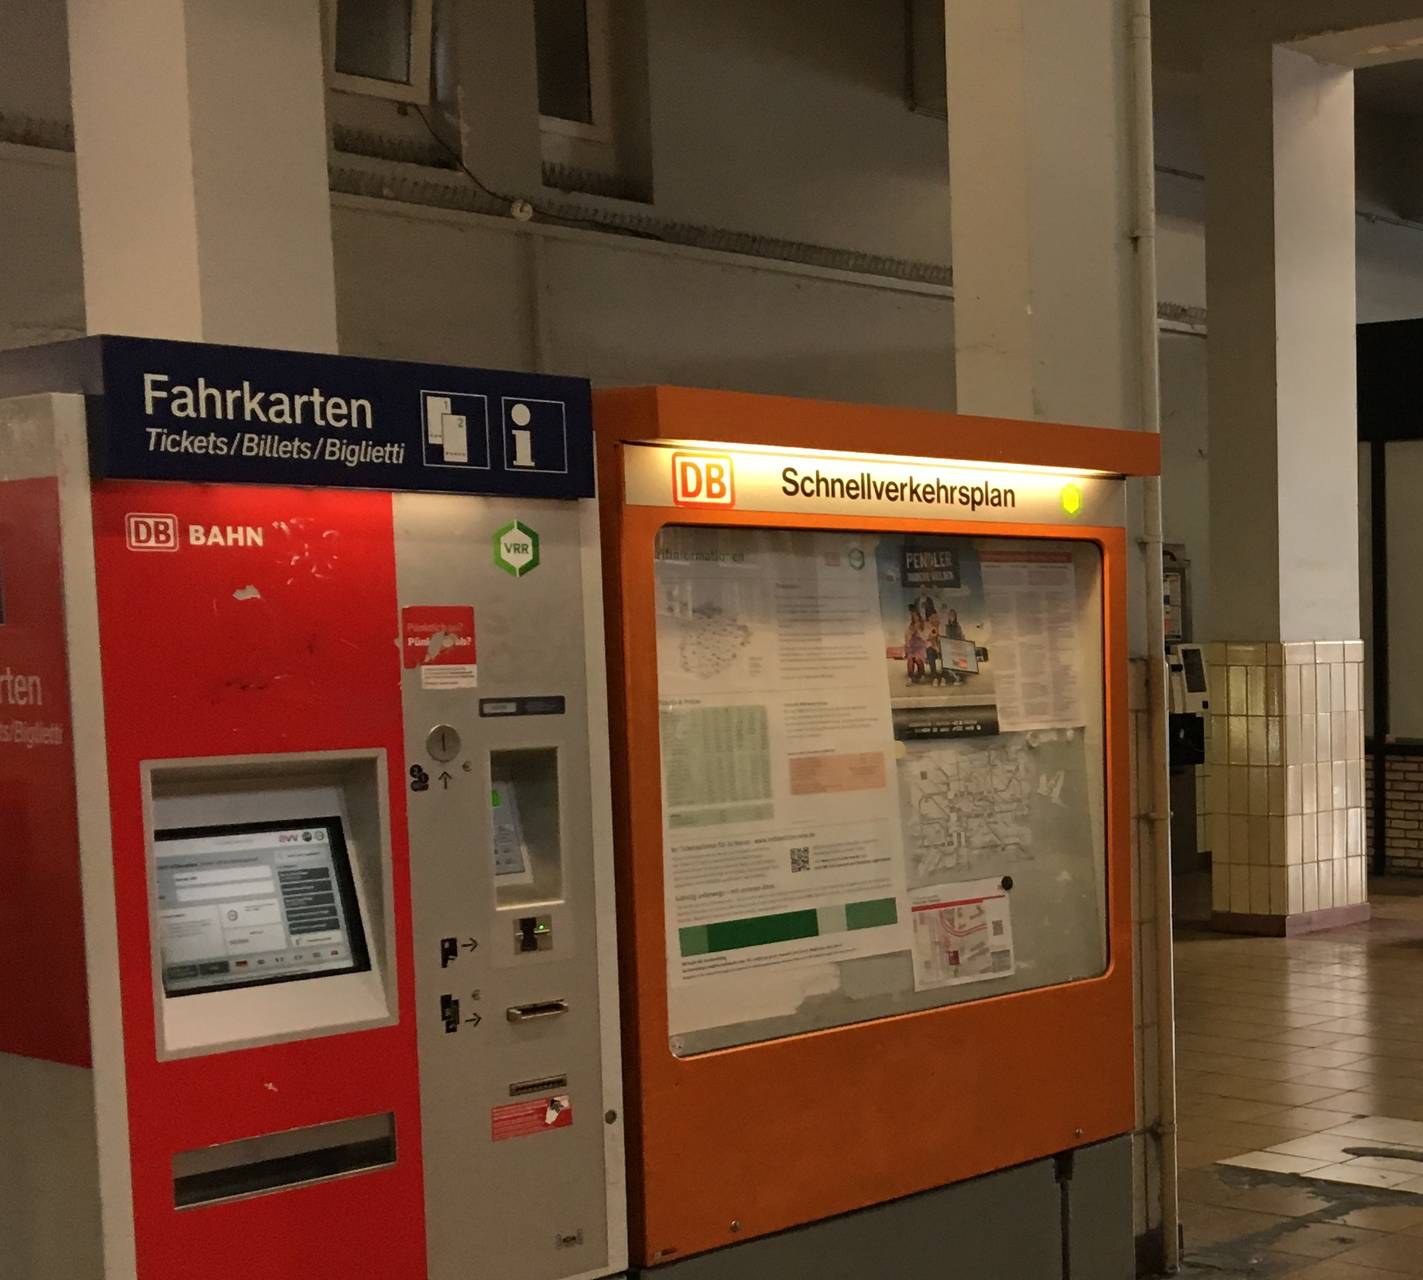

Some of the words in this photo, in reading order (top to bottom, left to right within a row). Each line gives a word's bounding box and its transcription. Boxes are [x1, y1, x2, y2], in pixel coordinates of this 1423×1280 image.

[143, 373, 373, 428] Fahrkarten
[680, 460, 725, 499] DB
[781, 466, 1016, 511] Schnellverkehrsplan
[132, 519, 172, 545] DB
[188, 523, 264, 547] BAHN
[503, 542, 529, 554] VRR
